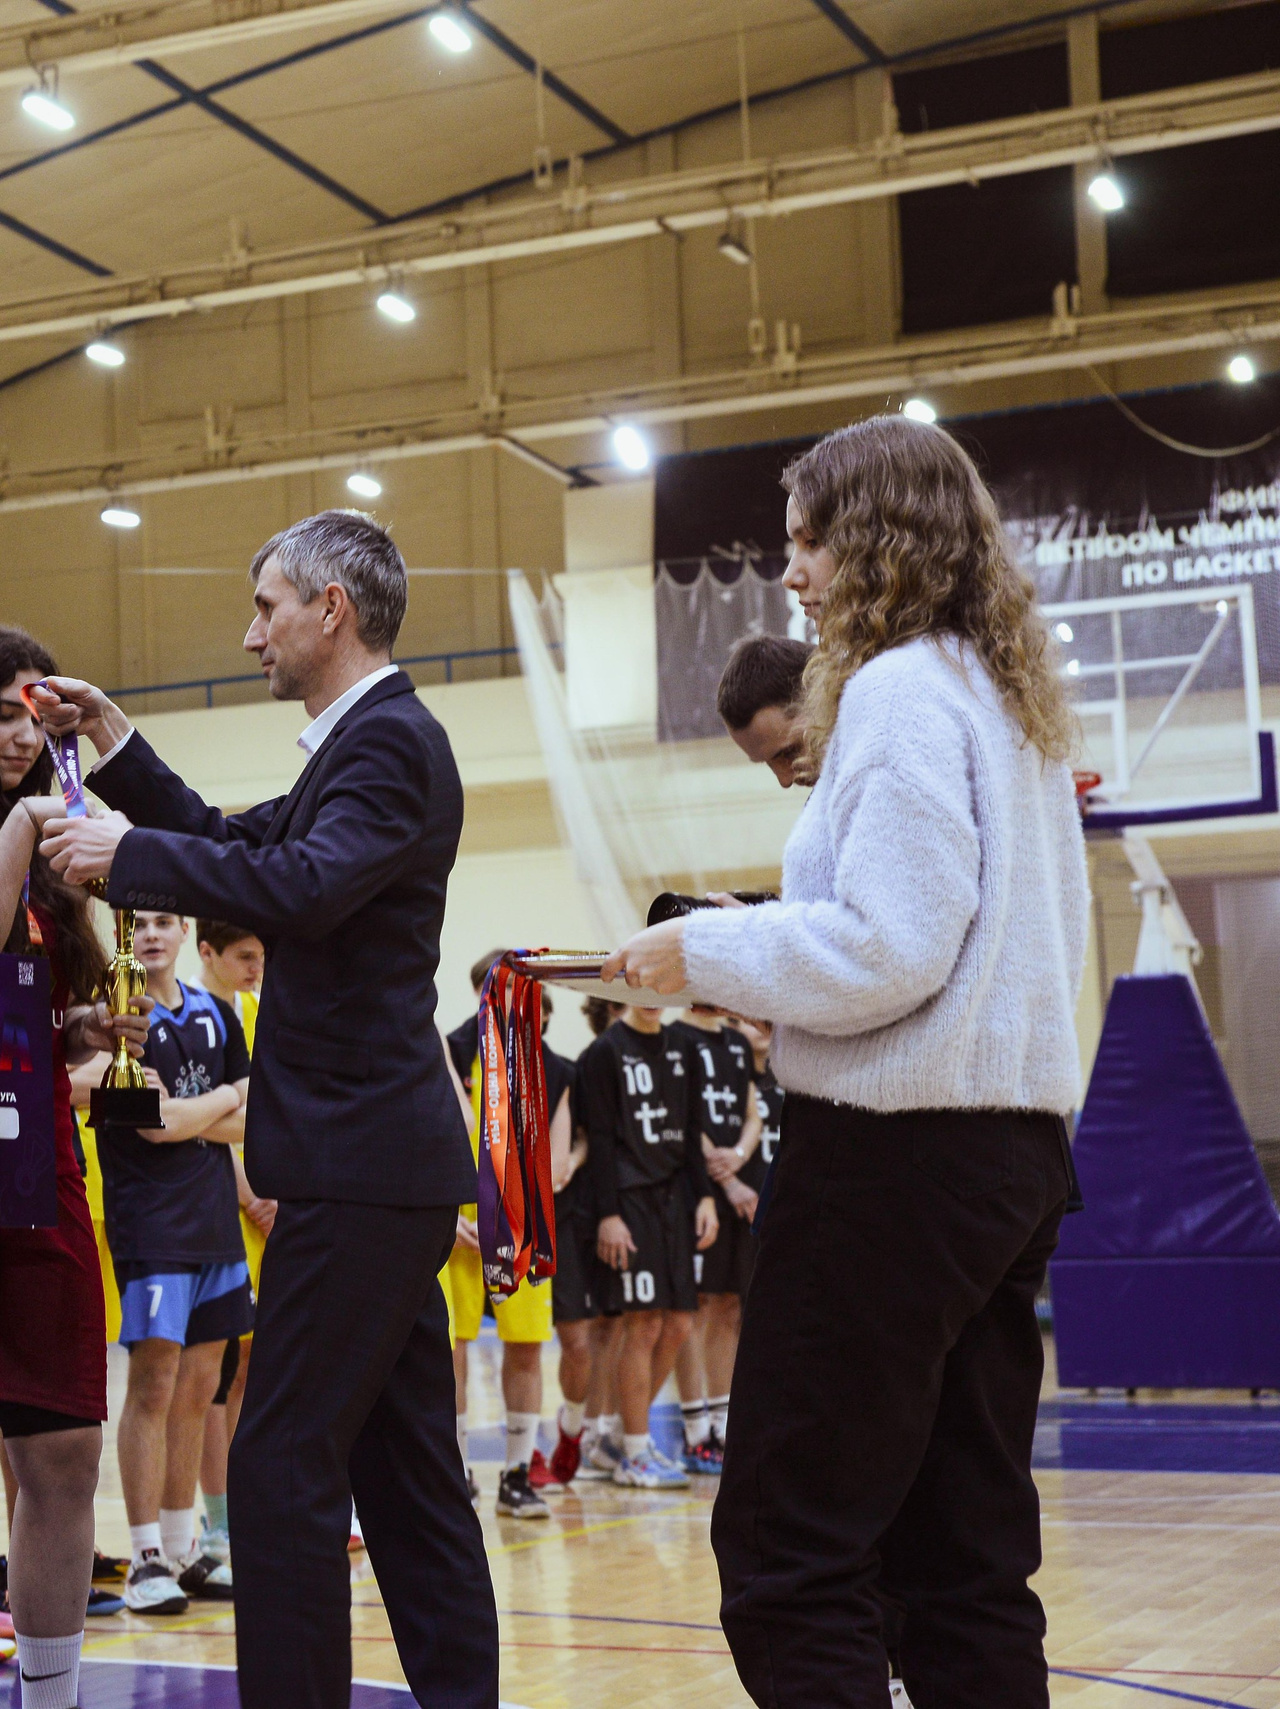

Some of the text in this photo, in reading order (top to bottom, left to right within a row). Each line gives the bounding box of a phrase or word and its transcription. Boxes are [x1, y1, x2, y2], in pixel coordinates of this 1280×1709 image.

[1122, 560, 1168, 588] ПО
[195, 1015, 216, 1049] 7
[622, 1062, 654, 1096] 10
[699, 1048, 716, 1078] 1
[150, 1284, 164, 1318] 7
[622, 1270, 656, 1303] 10
